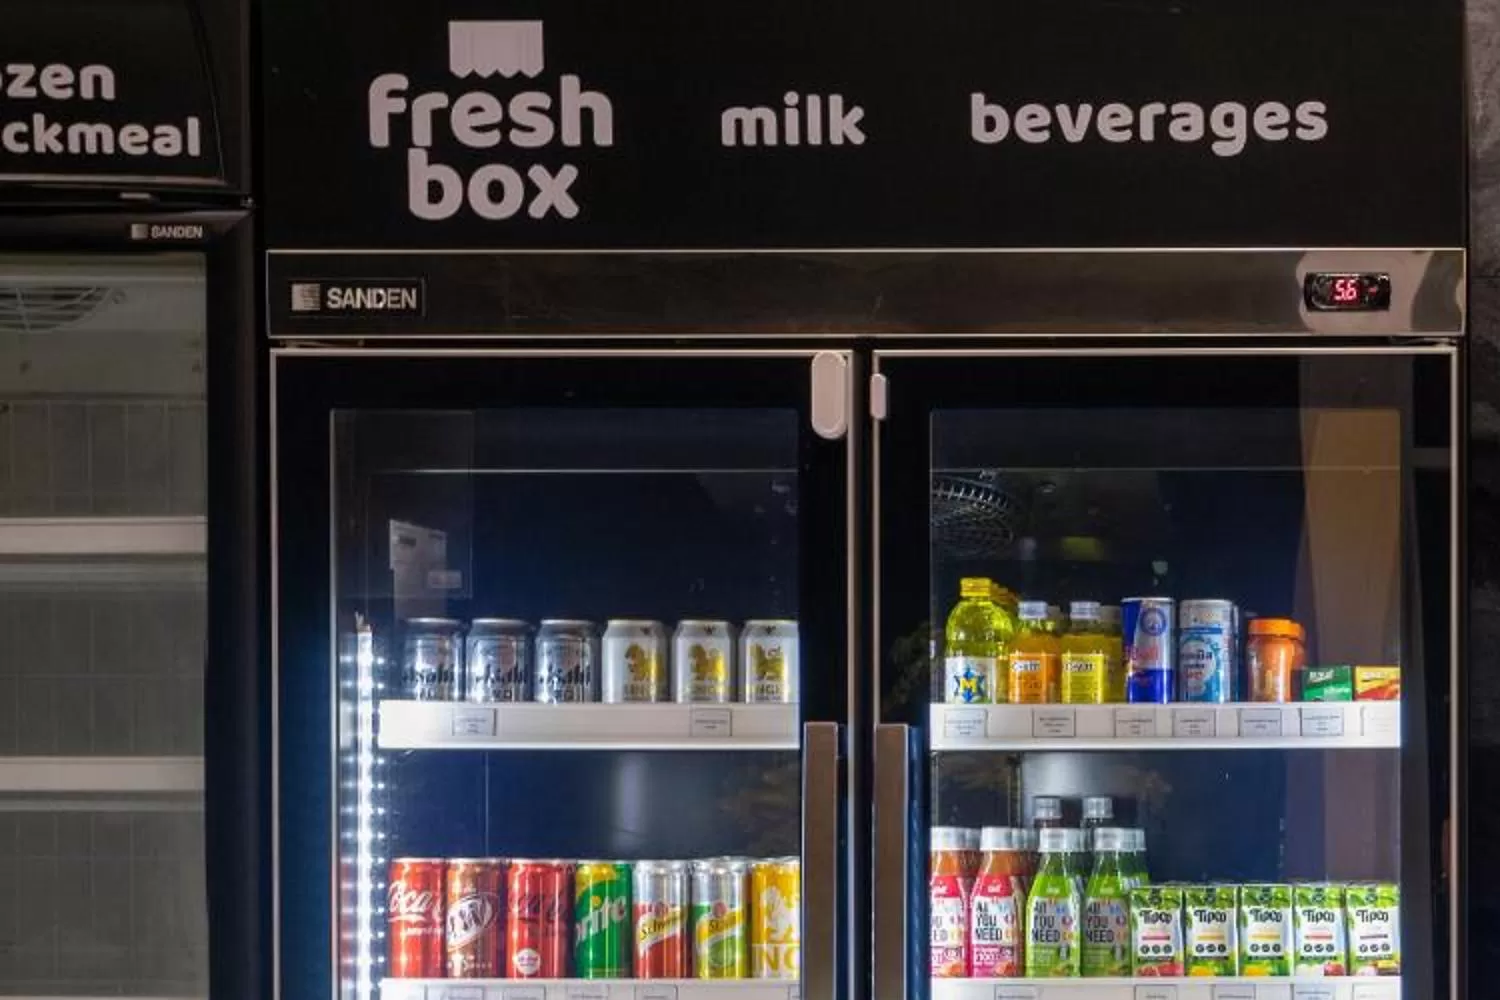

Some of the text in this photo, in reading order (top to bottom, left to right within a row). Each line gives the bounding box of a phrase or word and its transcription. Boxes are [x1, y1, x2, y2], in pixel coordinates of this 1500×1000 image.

[0, 63, 115, 100] zen
[369, 74, 613, 147] fresh
[721, 91, 866, 146] milk
[971, 92, 1328, 157] beverages
[408, 148, 579, 220] box
[151, 225, 203, 238] SANDEN
[327, 287, 417, 309] SANDEN
